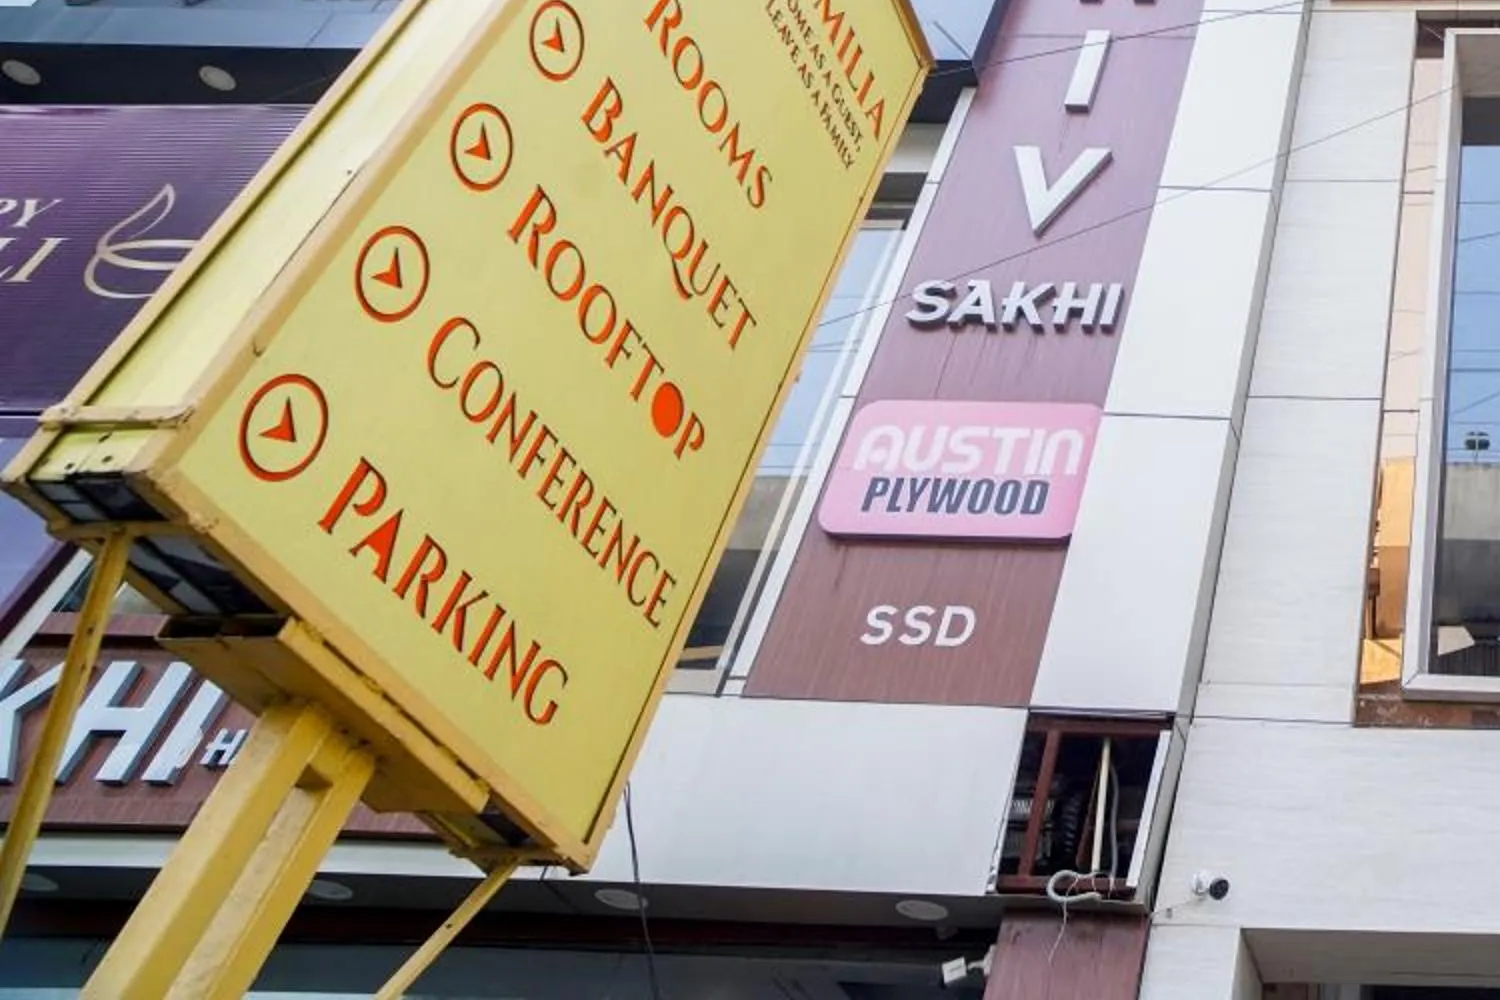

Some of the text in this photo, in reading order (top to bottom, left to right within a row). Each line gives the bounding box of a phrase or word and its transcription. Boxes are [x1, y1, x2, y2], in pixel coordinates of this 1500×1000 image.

[818, 100, 856, 170] FAMILY
[579, 76, 758, 352] BANQUET
[905, 279, 1123, 332] SAKHI
[426, 316, 678, 630] CONFERENCE
[852, 423, 1086, 476] AUSTIN
[860, 476, 1051, 516] PLYWOOD
[317, 455, 570, 726] PARKING
[860, 604, 977, 648] SSD
